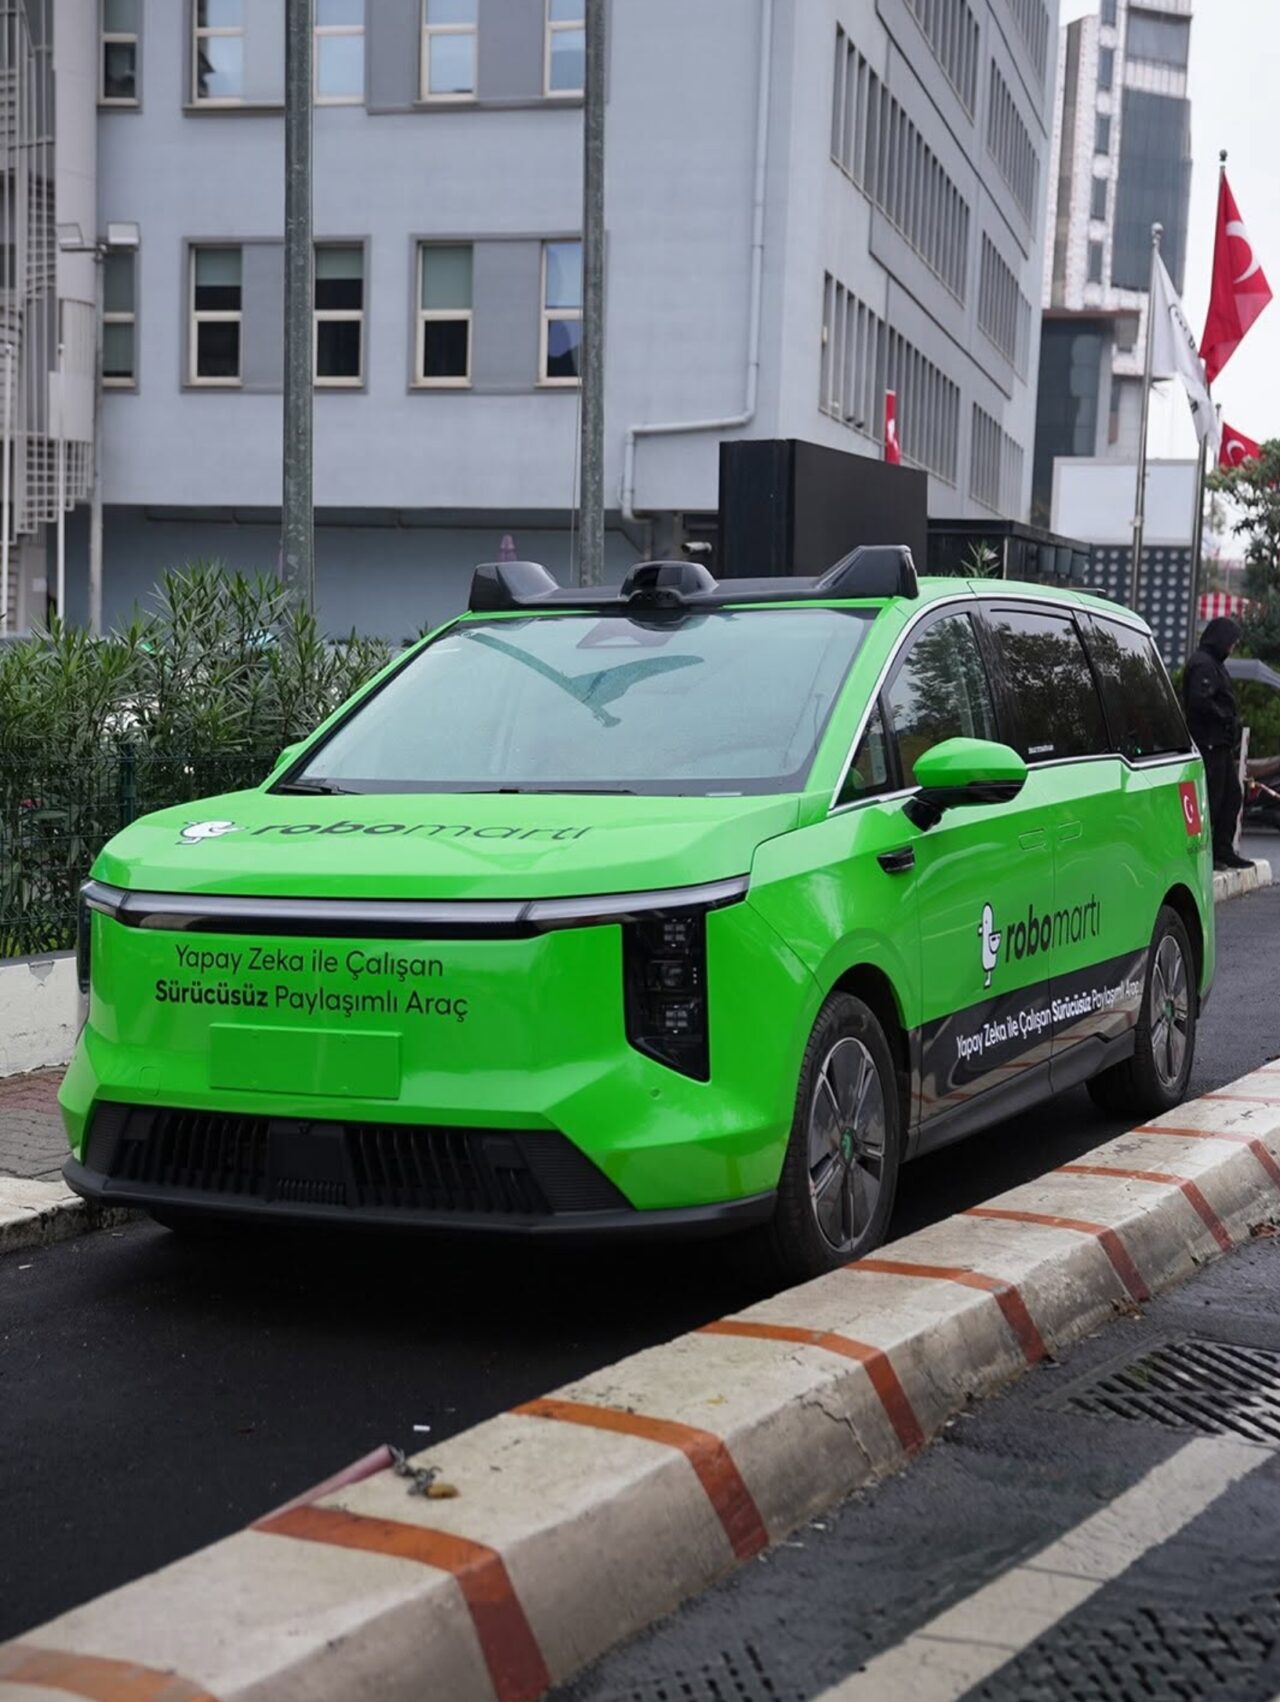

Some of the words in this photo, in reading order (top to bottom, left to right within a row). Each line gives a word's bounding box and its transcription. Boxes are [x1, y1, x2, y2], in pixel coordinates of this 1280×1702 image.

[175, 944, 242, 974] Yapay
[248, 947, 304, 971] Zeka
[311, 949, 338, 972] ile
[346, 950, 443, 982] Çalışan
[155, 979, 269, 1008] Sürücüsüz
[275, 984, 398, 1017] Paylaşımlı
[405, 991, 469, 1022] Araç
[956, 1032, 983, 1061] Yapay
[983, 1020, 1007, 1048] Zeka
[1006, 1015, 1019, 1038] ile
[1019, 1007, 1052, 1040] Çalışan
[1051, 991, 1092, 1022] Sürücüsüz
